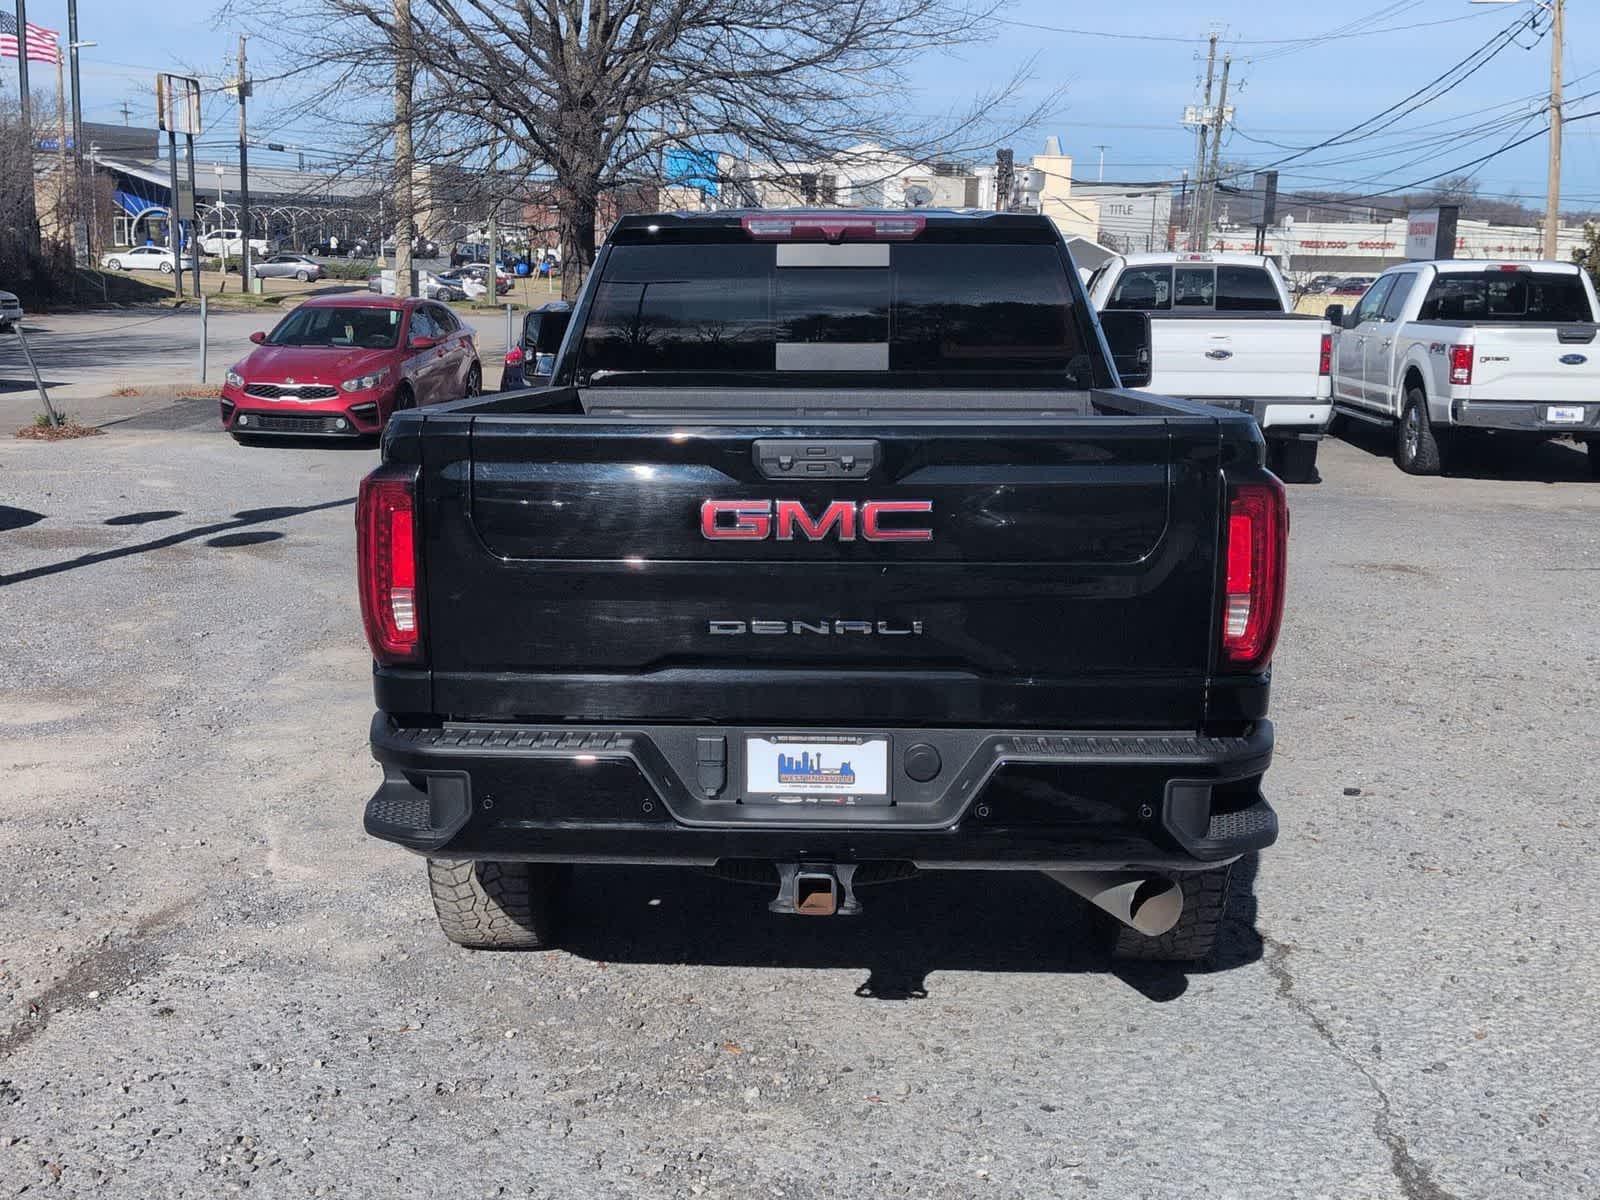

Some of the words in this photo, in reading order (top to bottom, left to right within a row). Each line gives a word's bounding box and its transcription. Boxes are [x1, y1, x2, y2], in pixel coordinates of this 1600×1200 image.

[1109, 204, 1134, 216] TITLE
[701, 499, 934, 542] GMC
[708, 620, 924, 636] DENALI
